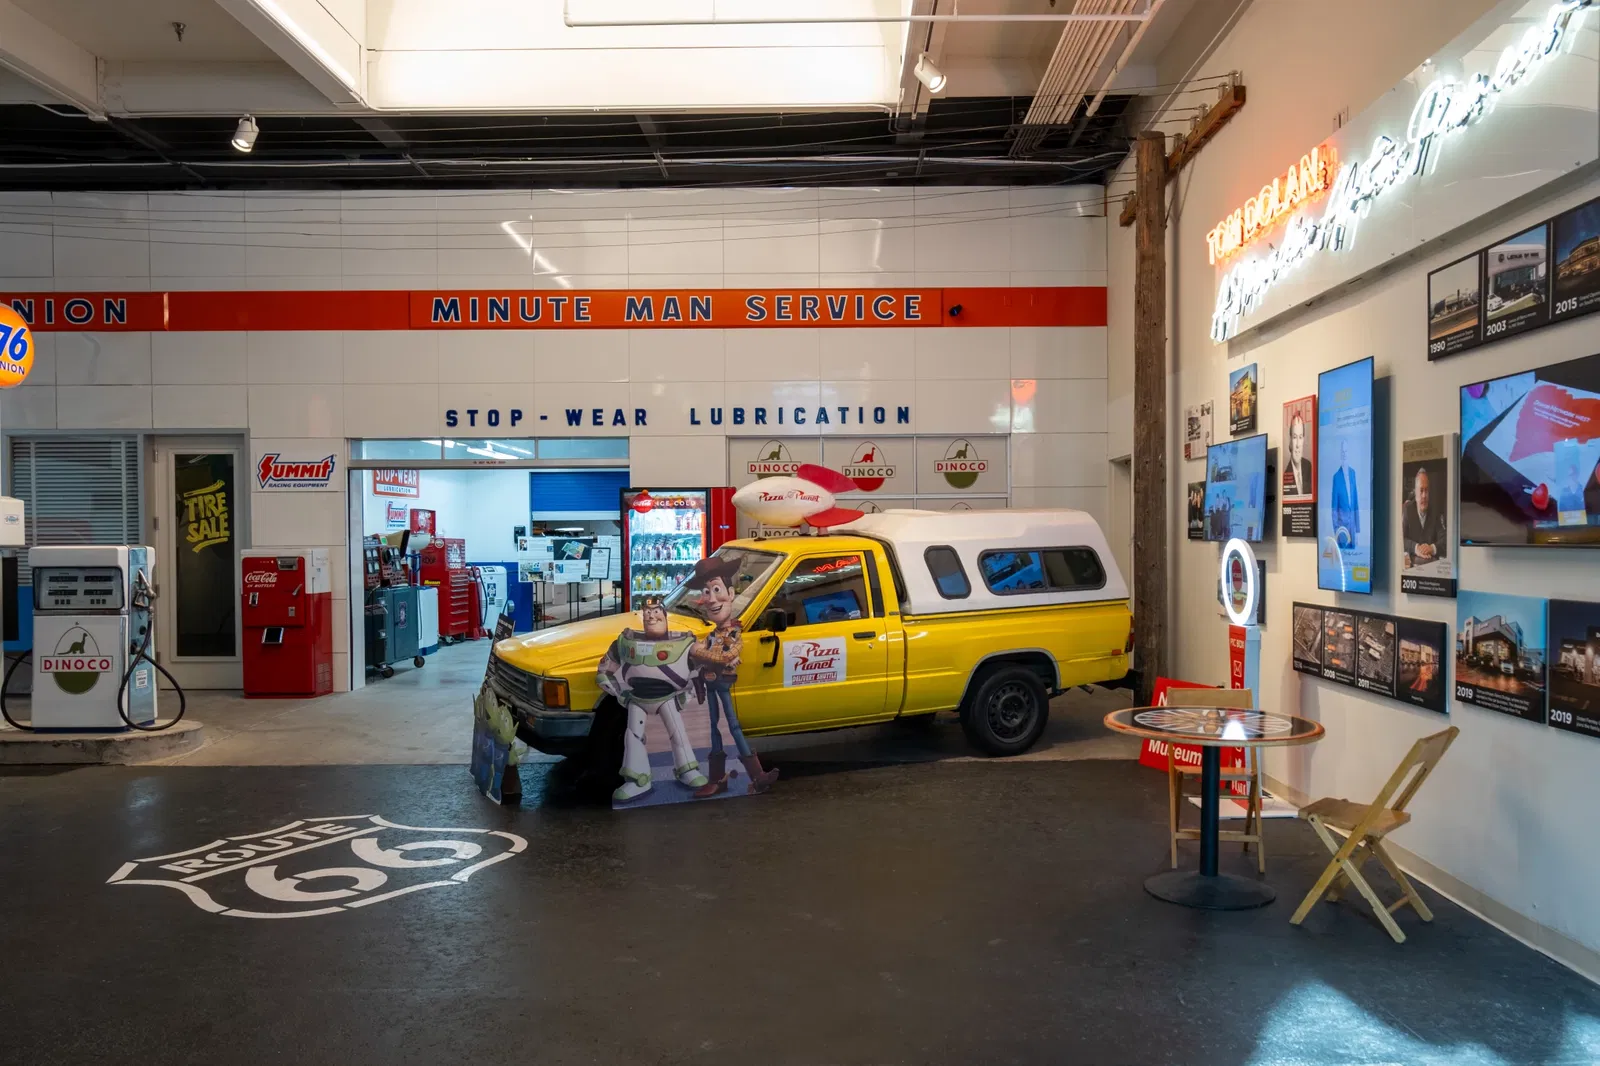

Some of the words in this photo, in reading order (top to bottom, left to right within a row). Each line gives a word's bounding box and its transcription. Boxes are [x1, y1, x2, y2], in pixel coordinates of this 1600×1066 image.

[431, 297, 591, 323] MINUTE
[624, 296, 713, 322] MAN
[745, 295, 922, 321] SERVICE
[1555, 297, 1577, 314] 2015
[1486, 320, 1507, 336] 2003
[1430, 341, 1446, 354] 1990
[690, 406, 910, 425] LUBRICATION
[750, 462, 800, 473] DINOCO
[844, 467, 895, 478] DINOCO
[936, 461, 987, 472] DINOCO
[184, 492, 228, 522] TIRE
[186, 512, 230, 543] SALE
[1402, 579, 1417, 590] 2010
[802, 642, 840, 657] Pizza
[44, 659, 110, 670] DINOCO
[1457, 686, 1473, 699] 2019
[1550, 709, 1572, 724] 2019
[1148, 740, 1202, 766] Mueum
[159, 823, 358, 873] ROUTE
[245, 838, 482, 901] 66
